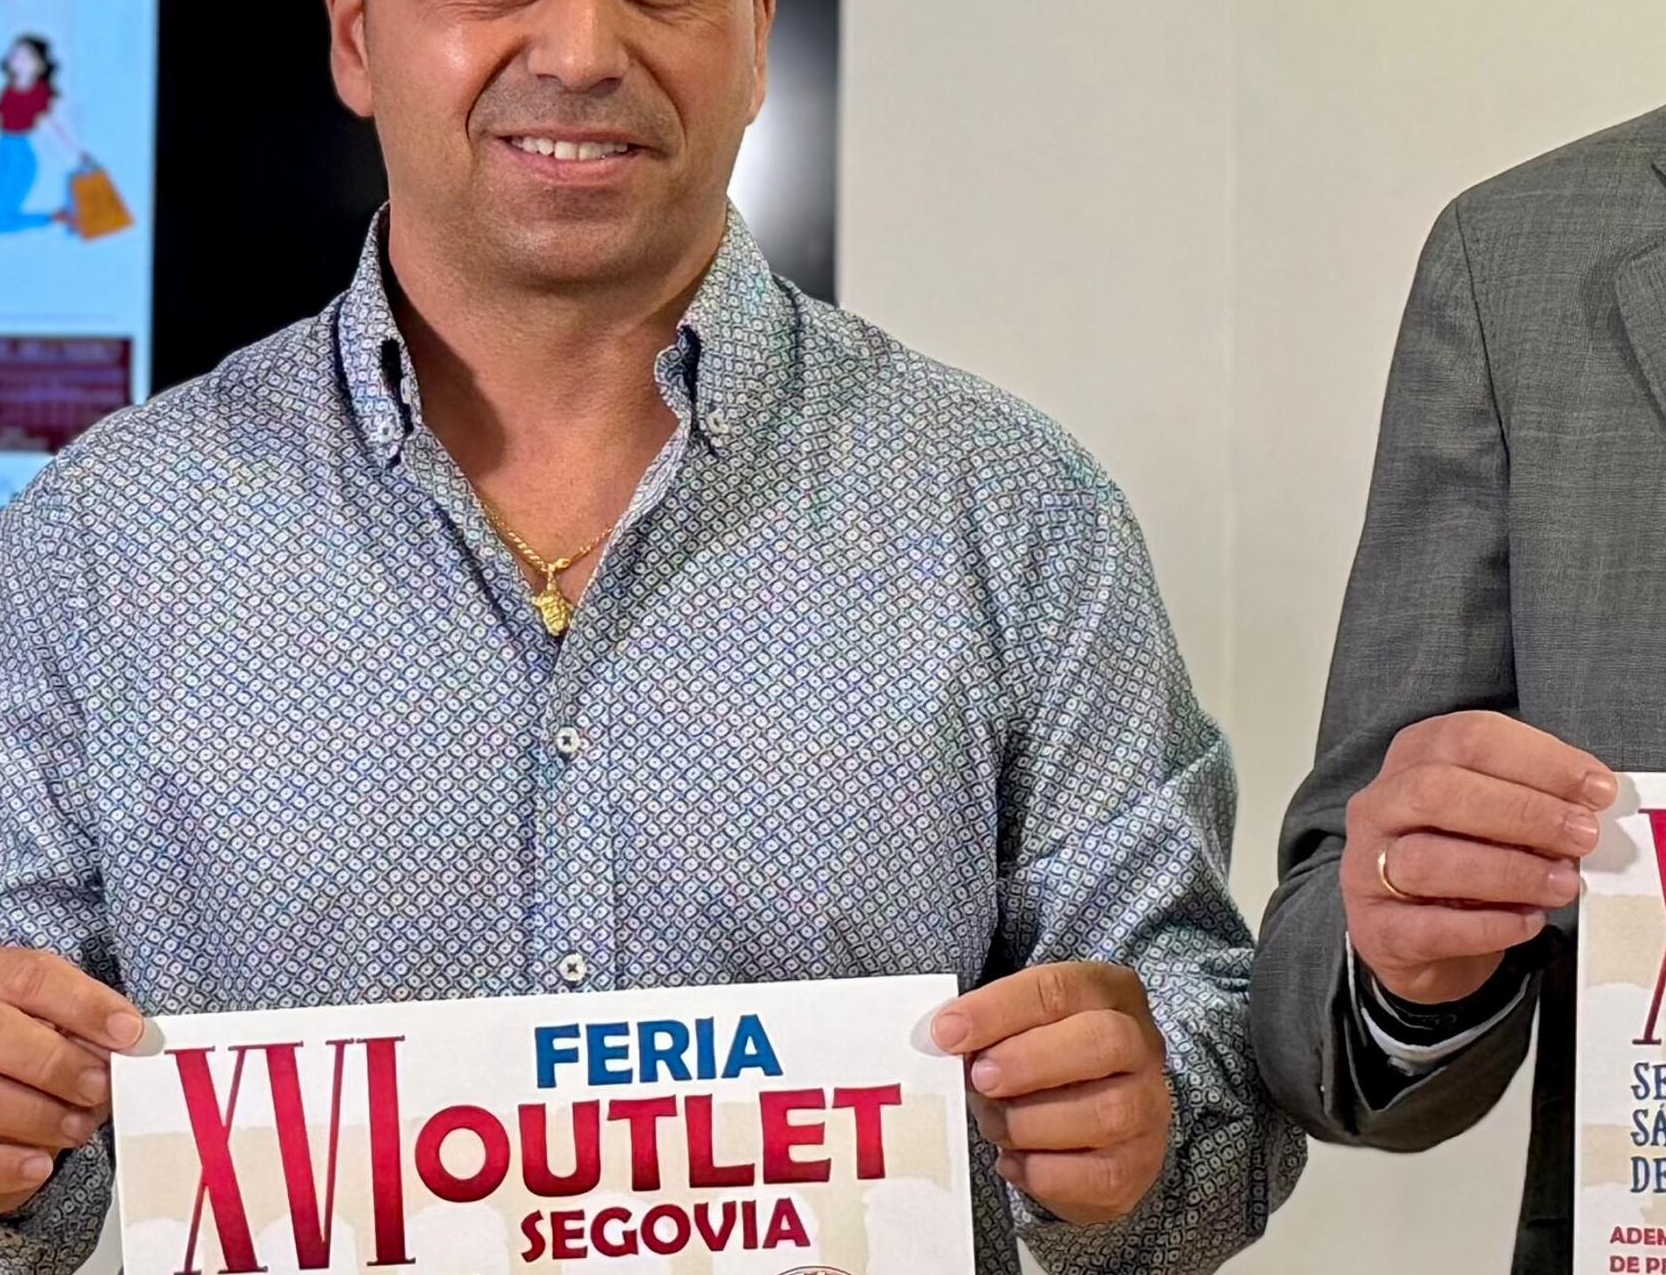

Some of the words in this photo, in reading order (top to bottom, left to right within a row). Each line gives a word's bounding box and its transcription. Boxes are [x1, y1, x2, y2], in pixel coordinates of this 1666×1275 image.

[534, 1013, 784, 1089] FERIA
[414, 1083, 902, 1203] OUTLET
[520, 1197, 811, 1263] SEGOVIA
